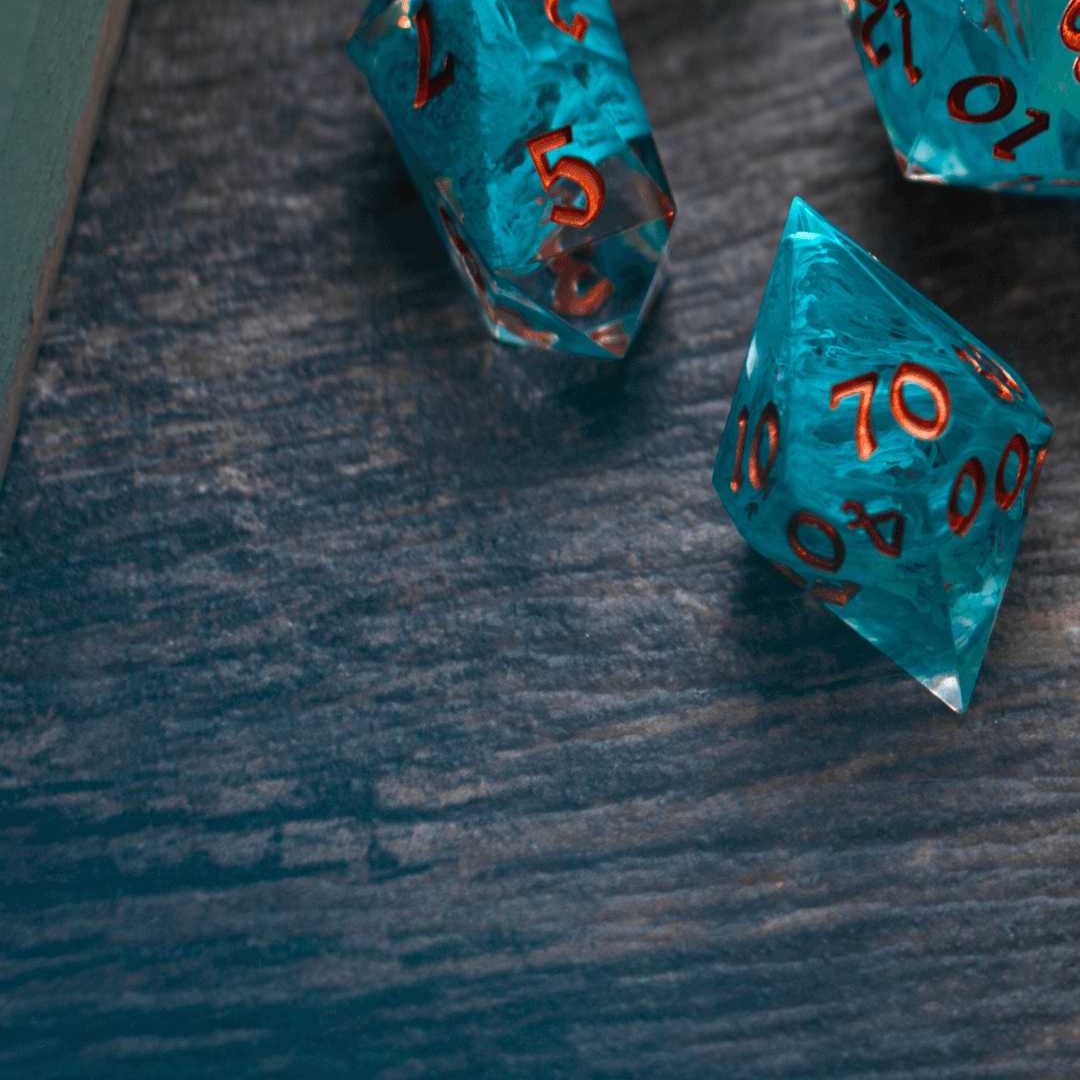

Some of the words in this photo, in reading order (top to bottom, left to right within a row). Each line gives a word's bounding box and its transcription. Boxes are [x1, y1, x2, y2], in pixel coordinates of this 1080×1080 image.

[526, 124, 606, 227] 5
[729, 401, 781, 493] 10
[829, 361, 951, 461] 70
[946, 434, 1029, 538] 00
